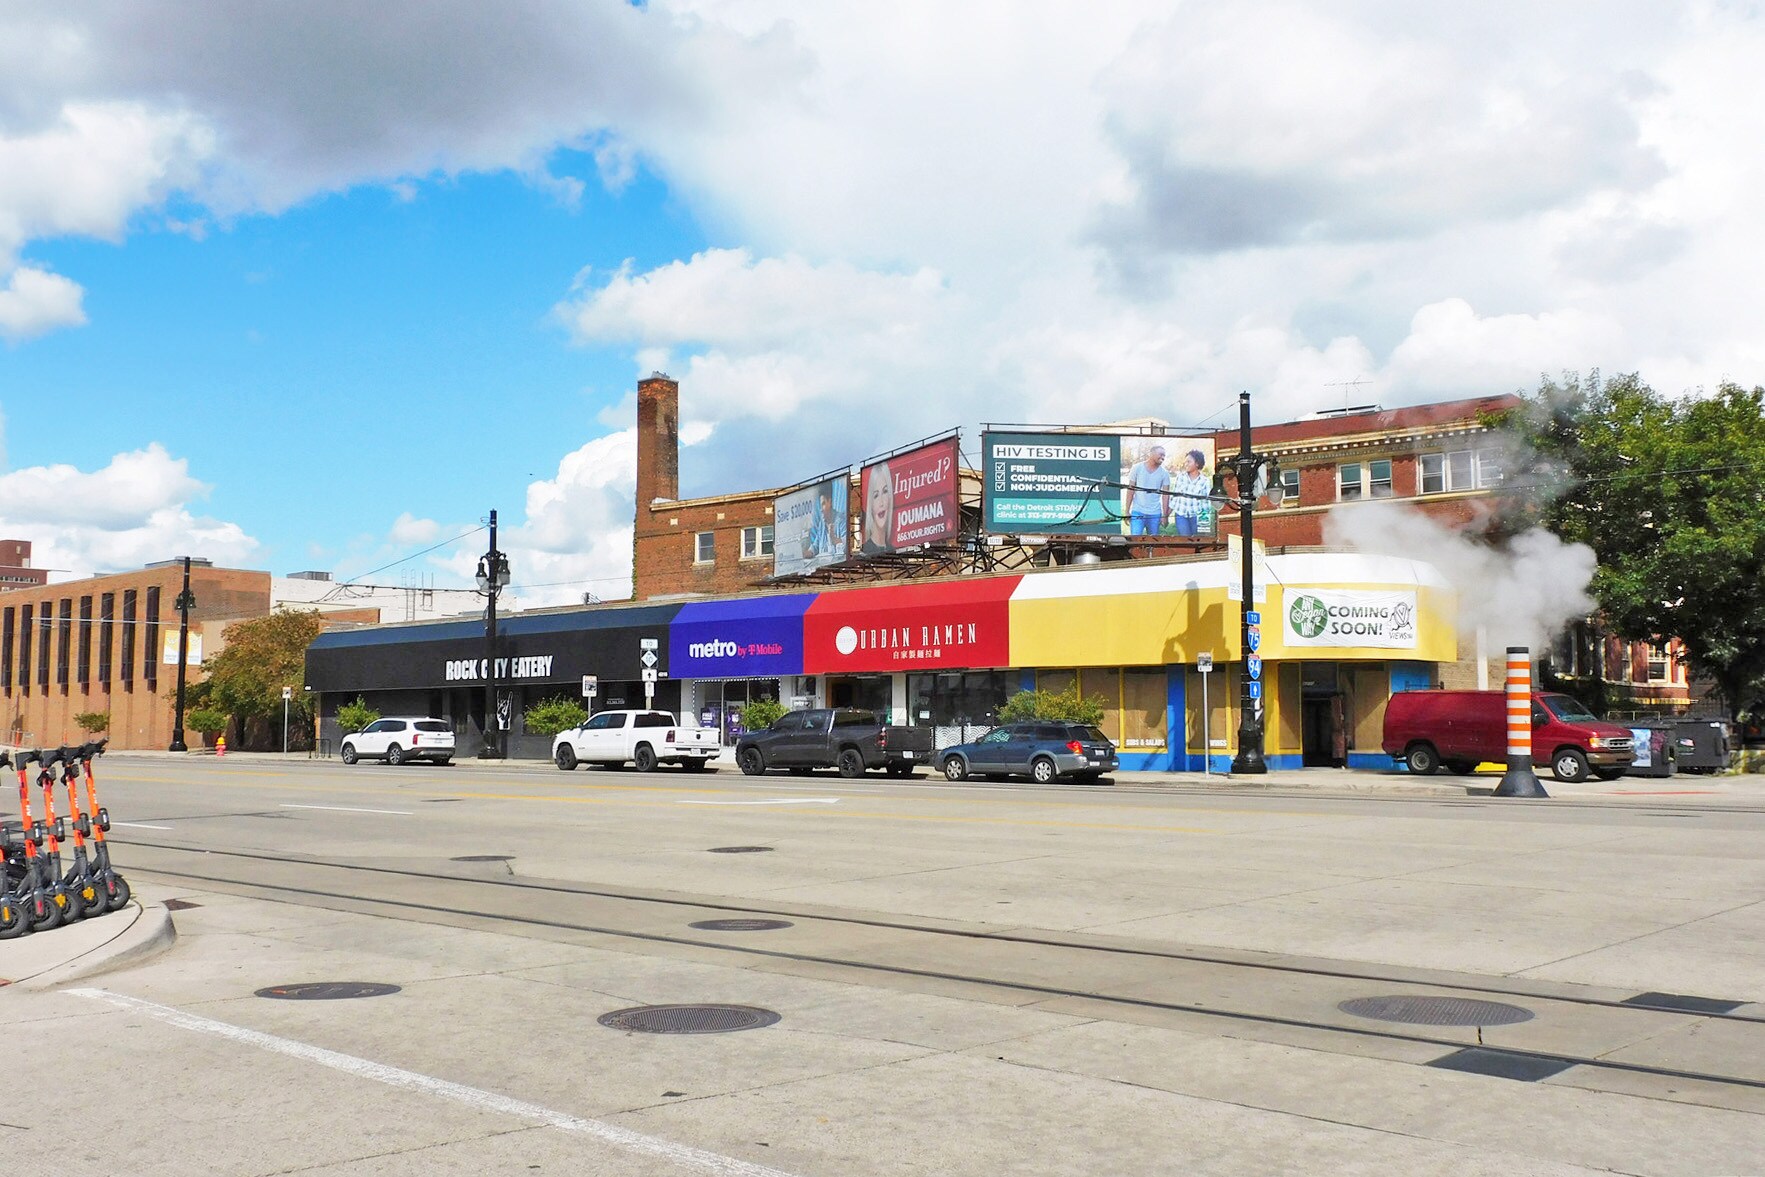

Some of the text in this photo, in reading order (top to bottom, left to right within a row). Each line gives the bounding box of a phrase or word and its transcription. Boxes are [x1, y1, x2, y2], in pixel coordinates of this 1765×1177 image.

[996, 447, 1106, 459] HIV TESTING IS
[1010, 465, 1035, 473] FREE
[894, 456, 951, 499] Injured?
[777, 509, 790, 523] Save
[897, 501, 944, 532] JOUMANA
[1250, 614, 1258, 622] TO
[1328, 605, 1389, 619] COMING
[1301, 622, 1315, 636] WAY
[1331, 622, 1383, 636] SOON!
[860, 623, 977, 650] URBAN RAMEN
[1249, 632, 1259, 645] 75
[689, 638, 737, 658] metro
[737, 646, 748, 658] by
[445, 655, 553, 681] ROCK CTY EATERY
[1249, 659, 1260, 673] 94
